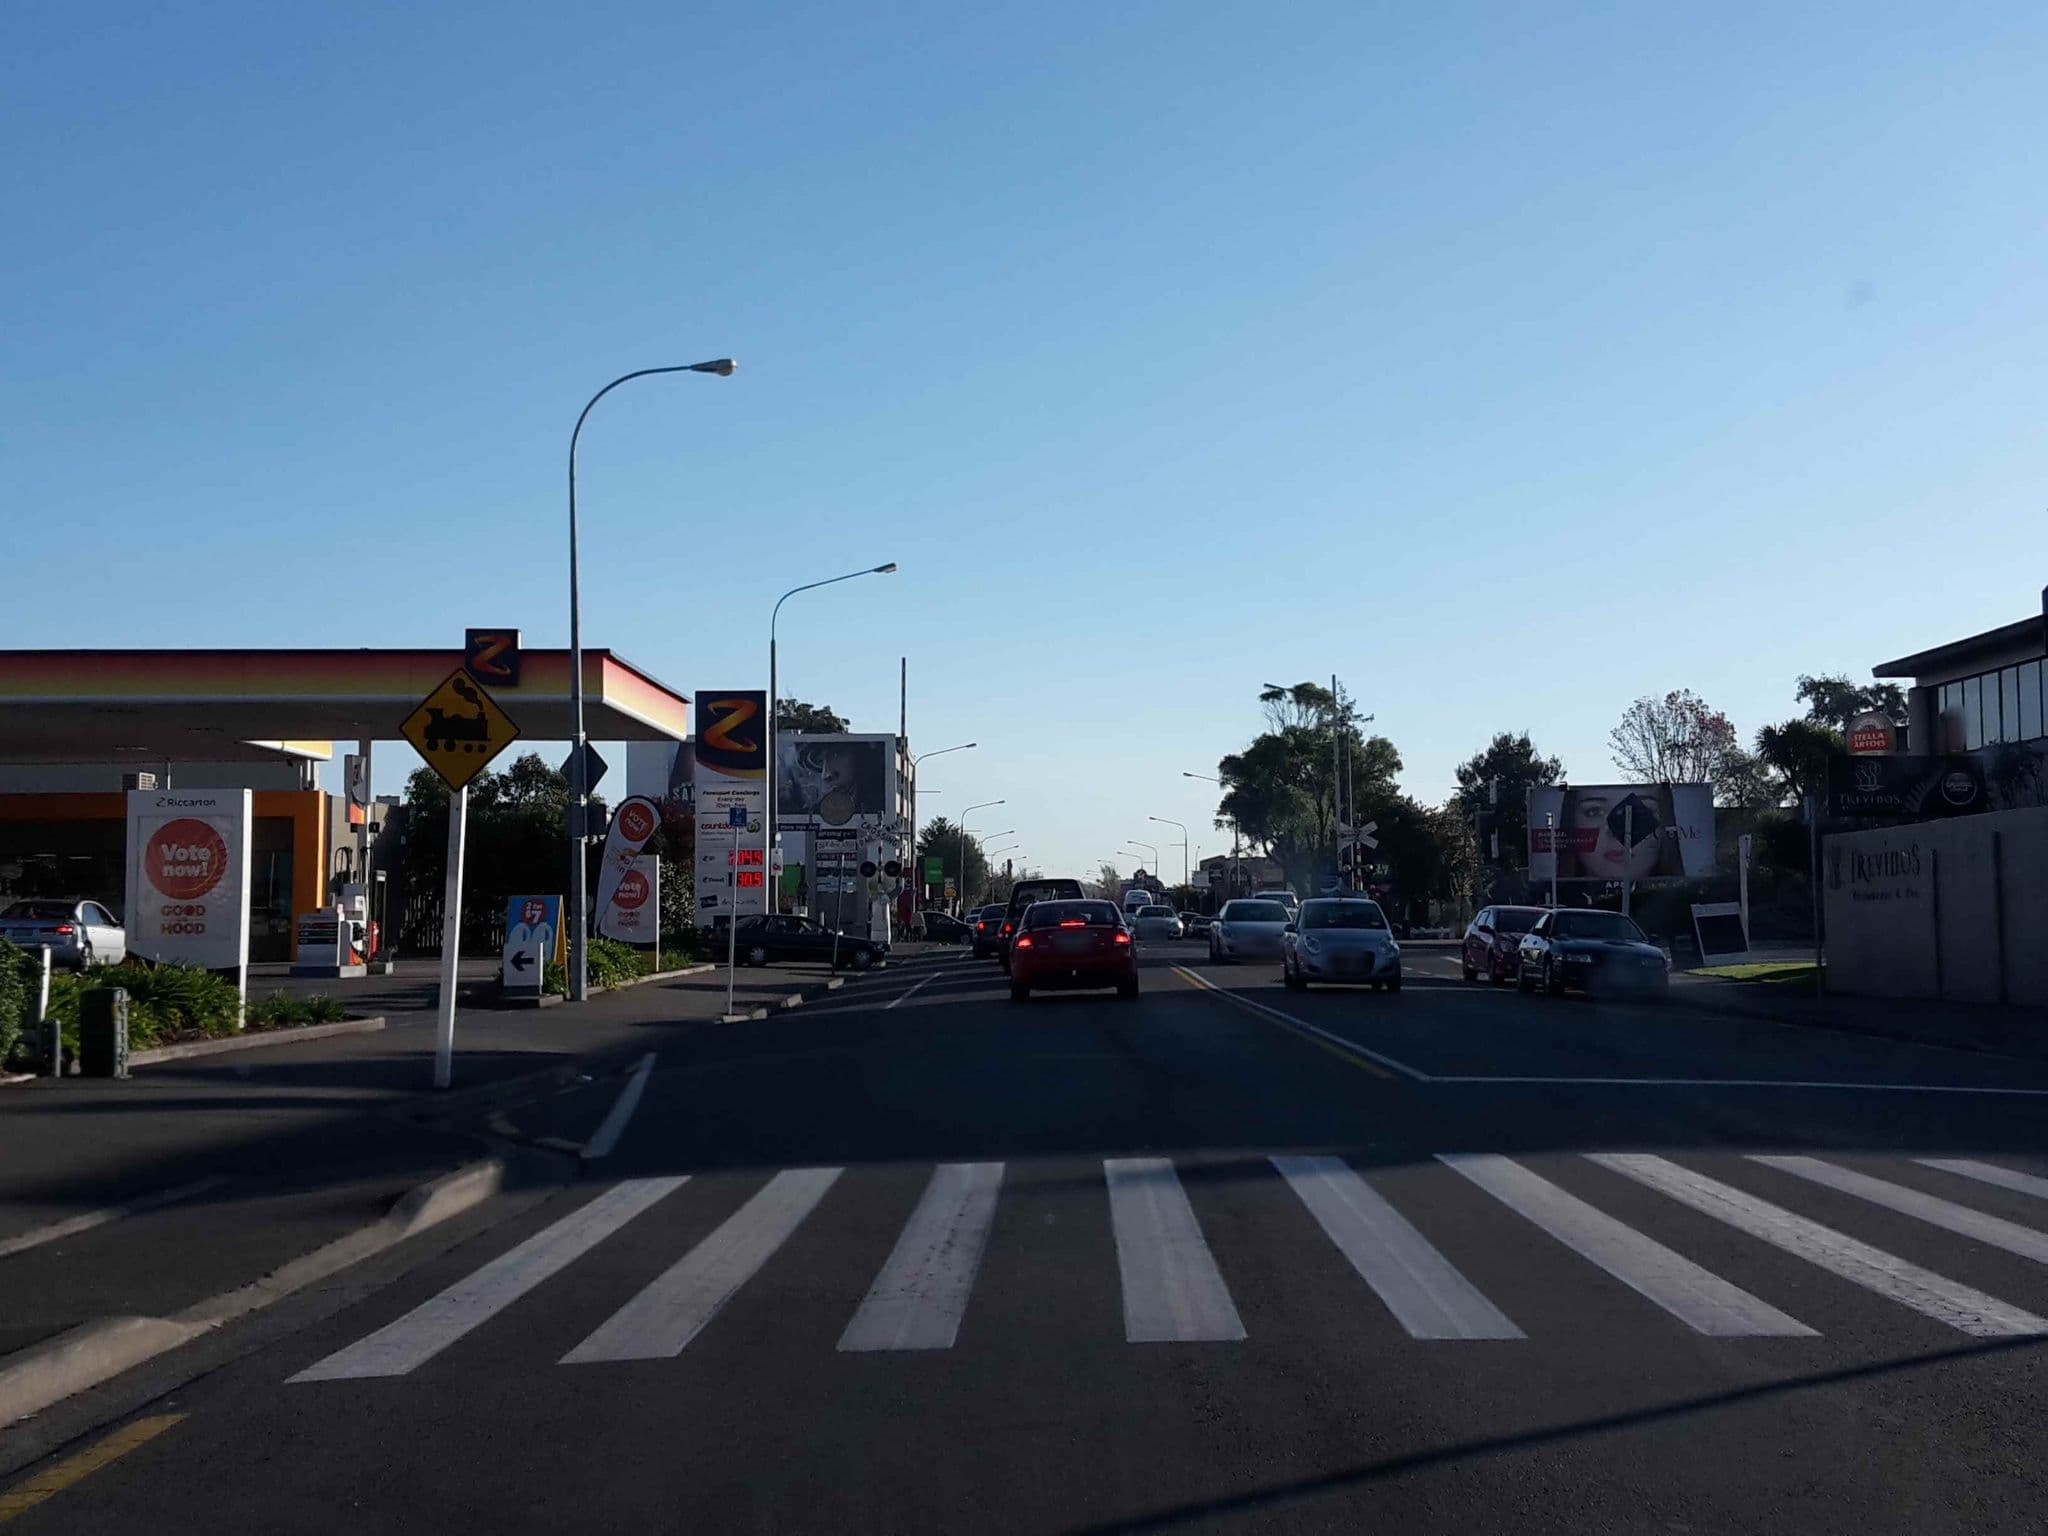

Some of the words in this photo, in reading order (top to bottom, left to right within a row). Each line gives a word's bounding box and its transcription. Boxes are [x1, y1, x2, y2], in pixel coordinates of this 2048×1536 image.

[1854, 732, 1884, 742] STELLA
[1854, 740, 1886, 749] ARTOIS
[167, 799, 216, 807] Riccarton
[161, 842, 211, 862] Vote
[163, 861, 208, 877] now!
[161, 904, 206, 916] GOOD
[161, 922, 206, 935] HOOD
